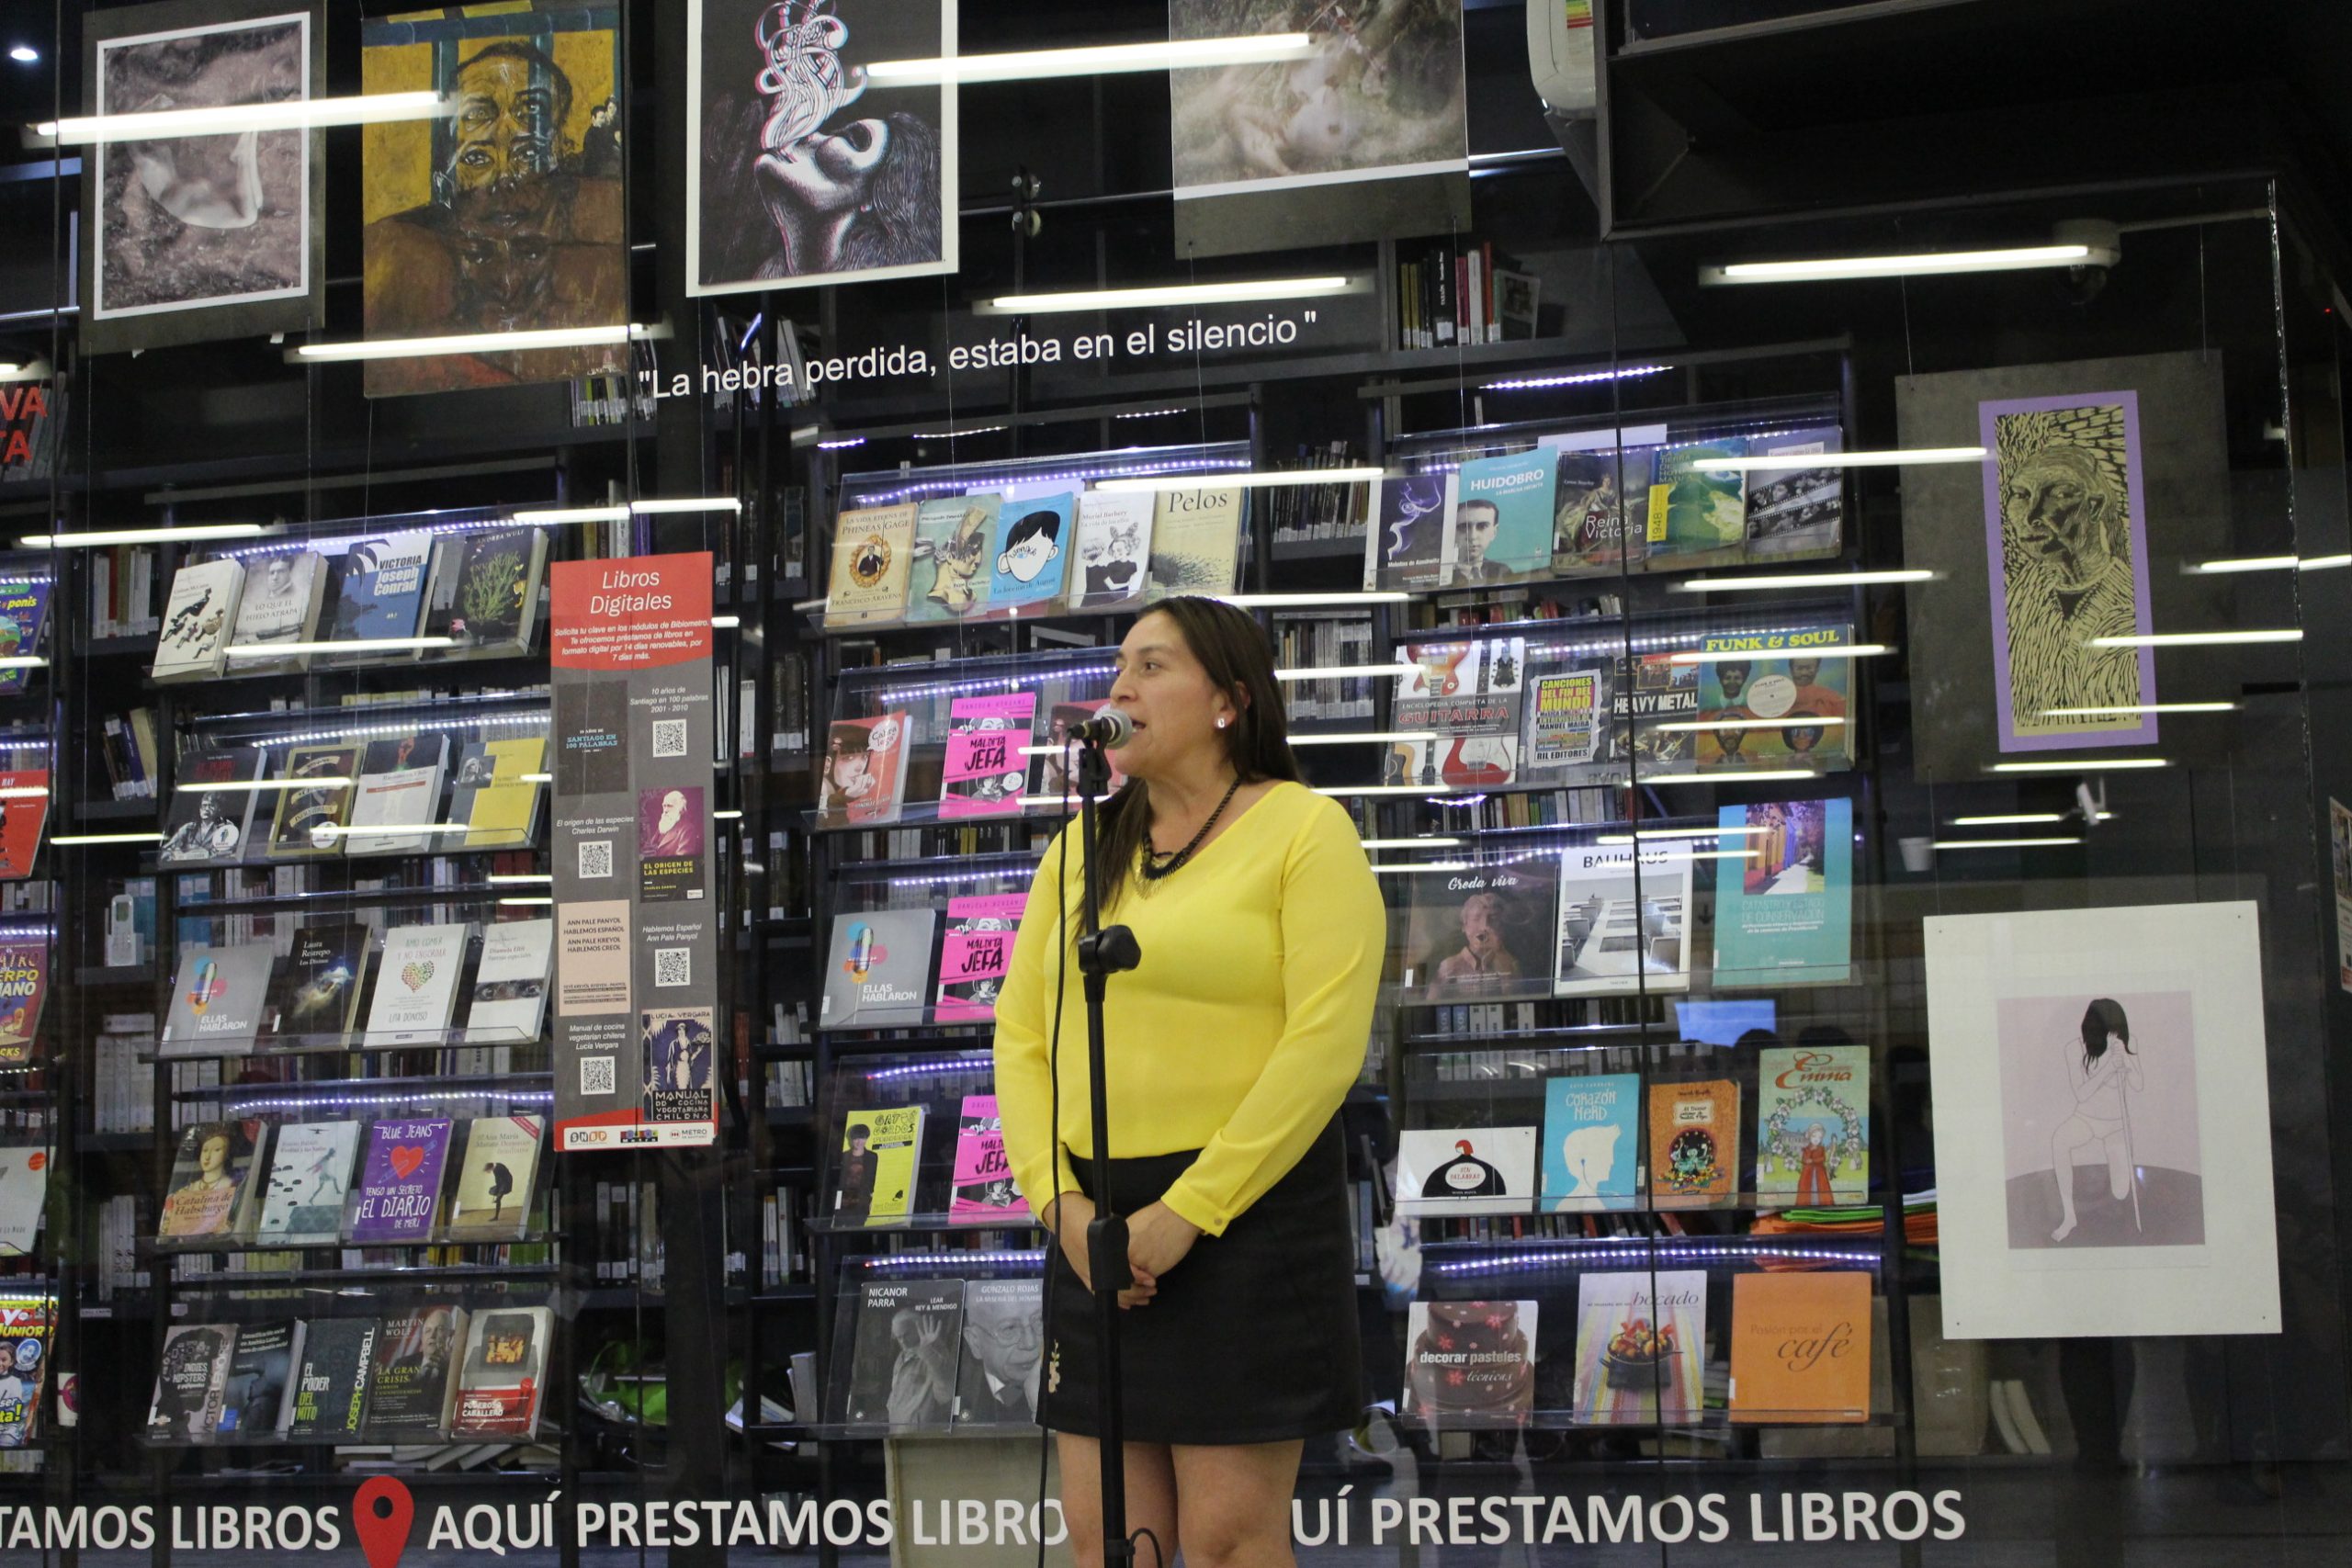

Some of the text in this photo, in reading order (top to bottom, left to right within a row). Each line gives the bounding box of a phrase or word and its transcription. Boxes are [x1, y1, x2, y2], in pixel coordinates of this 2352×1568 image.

[639, 313, 1297, 399] "La hebra perdida, estaba en el silencio
[0, 429, 32, 463] A
[1470, 468, 1544, 491] HUIDOBRO
[1168, 489, 1228, 513] Pelos
[842, 520, 910, 536] PHINEAS GAGE
[1585, 515, 1629, 529] Reina
[1585, 523, 1643, 540] Victoria
[379, 555, 422, 570] VICTORIA
[378, 567, 419, 584] Joseph
[602, 570, 660, 590] Libros
[374, 580, 417, 596] Conrad
[591, 592, 673, 617] Digitales
[588, 625, 605, 634] clave
[660, 621, 670, 629] de
[653, 632, 662, 640] de
[1705, 629, 1839, 652] FUNK & SOUL
[589, 645, 609, 655] digital
[690, 638, 703, 648] por
[1542, 677, 1592, 689] CANCIONES
[651, 686, 686, 695] 10 años de
[629, 697, 657, 706] Santiago
[669, 695, 681, 704] 100
[682, 694, 709, 704] palabras
[1402, 702, 1448, 710] ENCICLOPEDIA
[1540, 695, 1591, 711] MUNDO
[1614, 693, 1698, 714] HEAVY METAL
[650, 704, 689, 714] 2001 2010
[1398, 706, 1510, 725] GUITARRA
[579, 740, 618, 749] PALABRAS
[965, 745, 1007, 771] JEFA
[1537, 750, 1588, 760] RIL EDITORES
[564, 816, 635, 827] origen de especies
[571, 826, 619, 836] Charles Darwin
[644, 866, 694, 876] LAS ESPECIES
[654, 861, 682, 869] ORIGEN
[642, 922, 702, 933] Hablemos Español
[646, 932, 698, 942] Ann Pale Panyol
[967, 937, 1004, 951] MALDITA
[961, 946, 1004, 974] JEFA
[862, 983, 893, 993] ELLAS
[862, 991, 917, 1003] HABLARON
[201, 1014, 228, 1024] ELLAS
[677, 1011, 711, 1020] VERGARA
[198, 1021, 248, 1032] HABLARON
[569, 1024, 593, 1032] Manual
[603, 1022, 626, 1031] cocina
[602, 1032, 626, 1040] chilena
[594, 1042, 619, 1051] Vergara
[1775, 1051, 1853, 1089] Emma
[655, 1090, 709, 1100] MANUAL
[381, 1125, 434, 1140] BLUE JEANS
[366, 1187, 385, 1195] TENGO
[175, 1194, 219, 1207] Catalina
[361, 1195, 431, 1219] EL DIARIO
[175, 1204, 229, 1217] Habsburgo
[868, 1287, 908, 1297] NICANOR
[1633, 1290, 1699, 1305] bocado
[867, 1298, 896, 1307] PARRA
[932, 1303, 957, 1311] MENDIGO
[387, 1317, 424, 1328] MARTIN
[385, 1328, 413, 1337] WOLF
[1778, 1322, 1852, 1372] café
[1419, 1350, 1521, 1365] decorar pasteles
[304, 1362, 314, 1377] EL
[393, 1365, 421, 1374] GRAN
[1466, 1370, 1512, 1382] técnicas
[301, 1376, 330, 1392] PODER
[299, 1392, 314, 1406] DEL
[172, 1505, 341, 1551] LIBROS
[427, 1490, 562, 1557] AQUÍ
[577, 1499, 893, 1548] PRESTAMOS
[1372, 1494, 1730, 1547] PRESTAMOS
[1749, 1490, 1966, 1543] LIBROS
